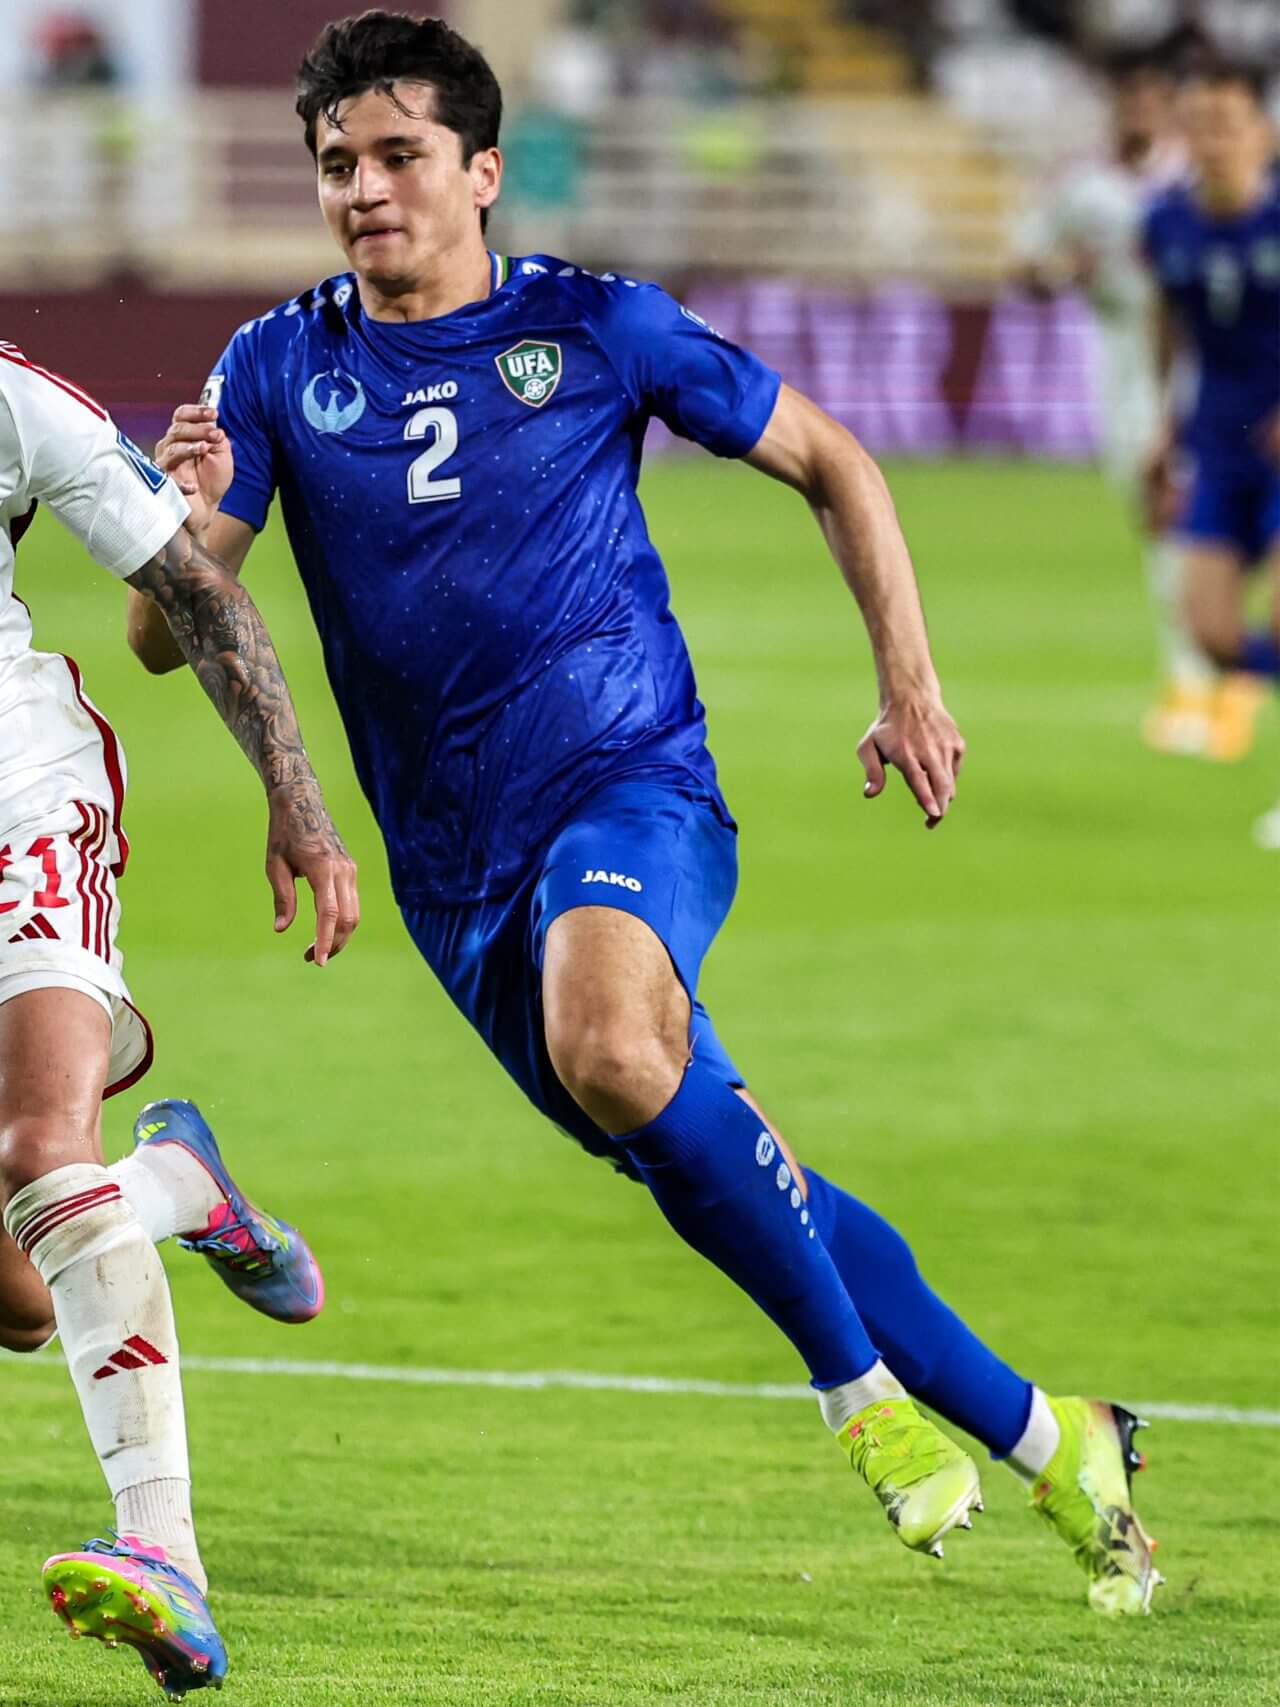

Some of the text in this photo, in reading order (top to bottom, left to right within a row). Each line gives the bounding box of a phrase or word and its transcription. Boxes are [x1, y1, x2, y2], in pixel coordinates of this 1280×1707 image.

[506, 351, 555, 378] UFA
[401, 380, 459, 406] JAKO
[403, 406, 462, 505] 2
[581, 869, 643, 893] JAKO
